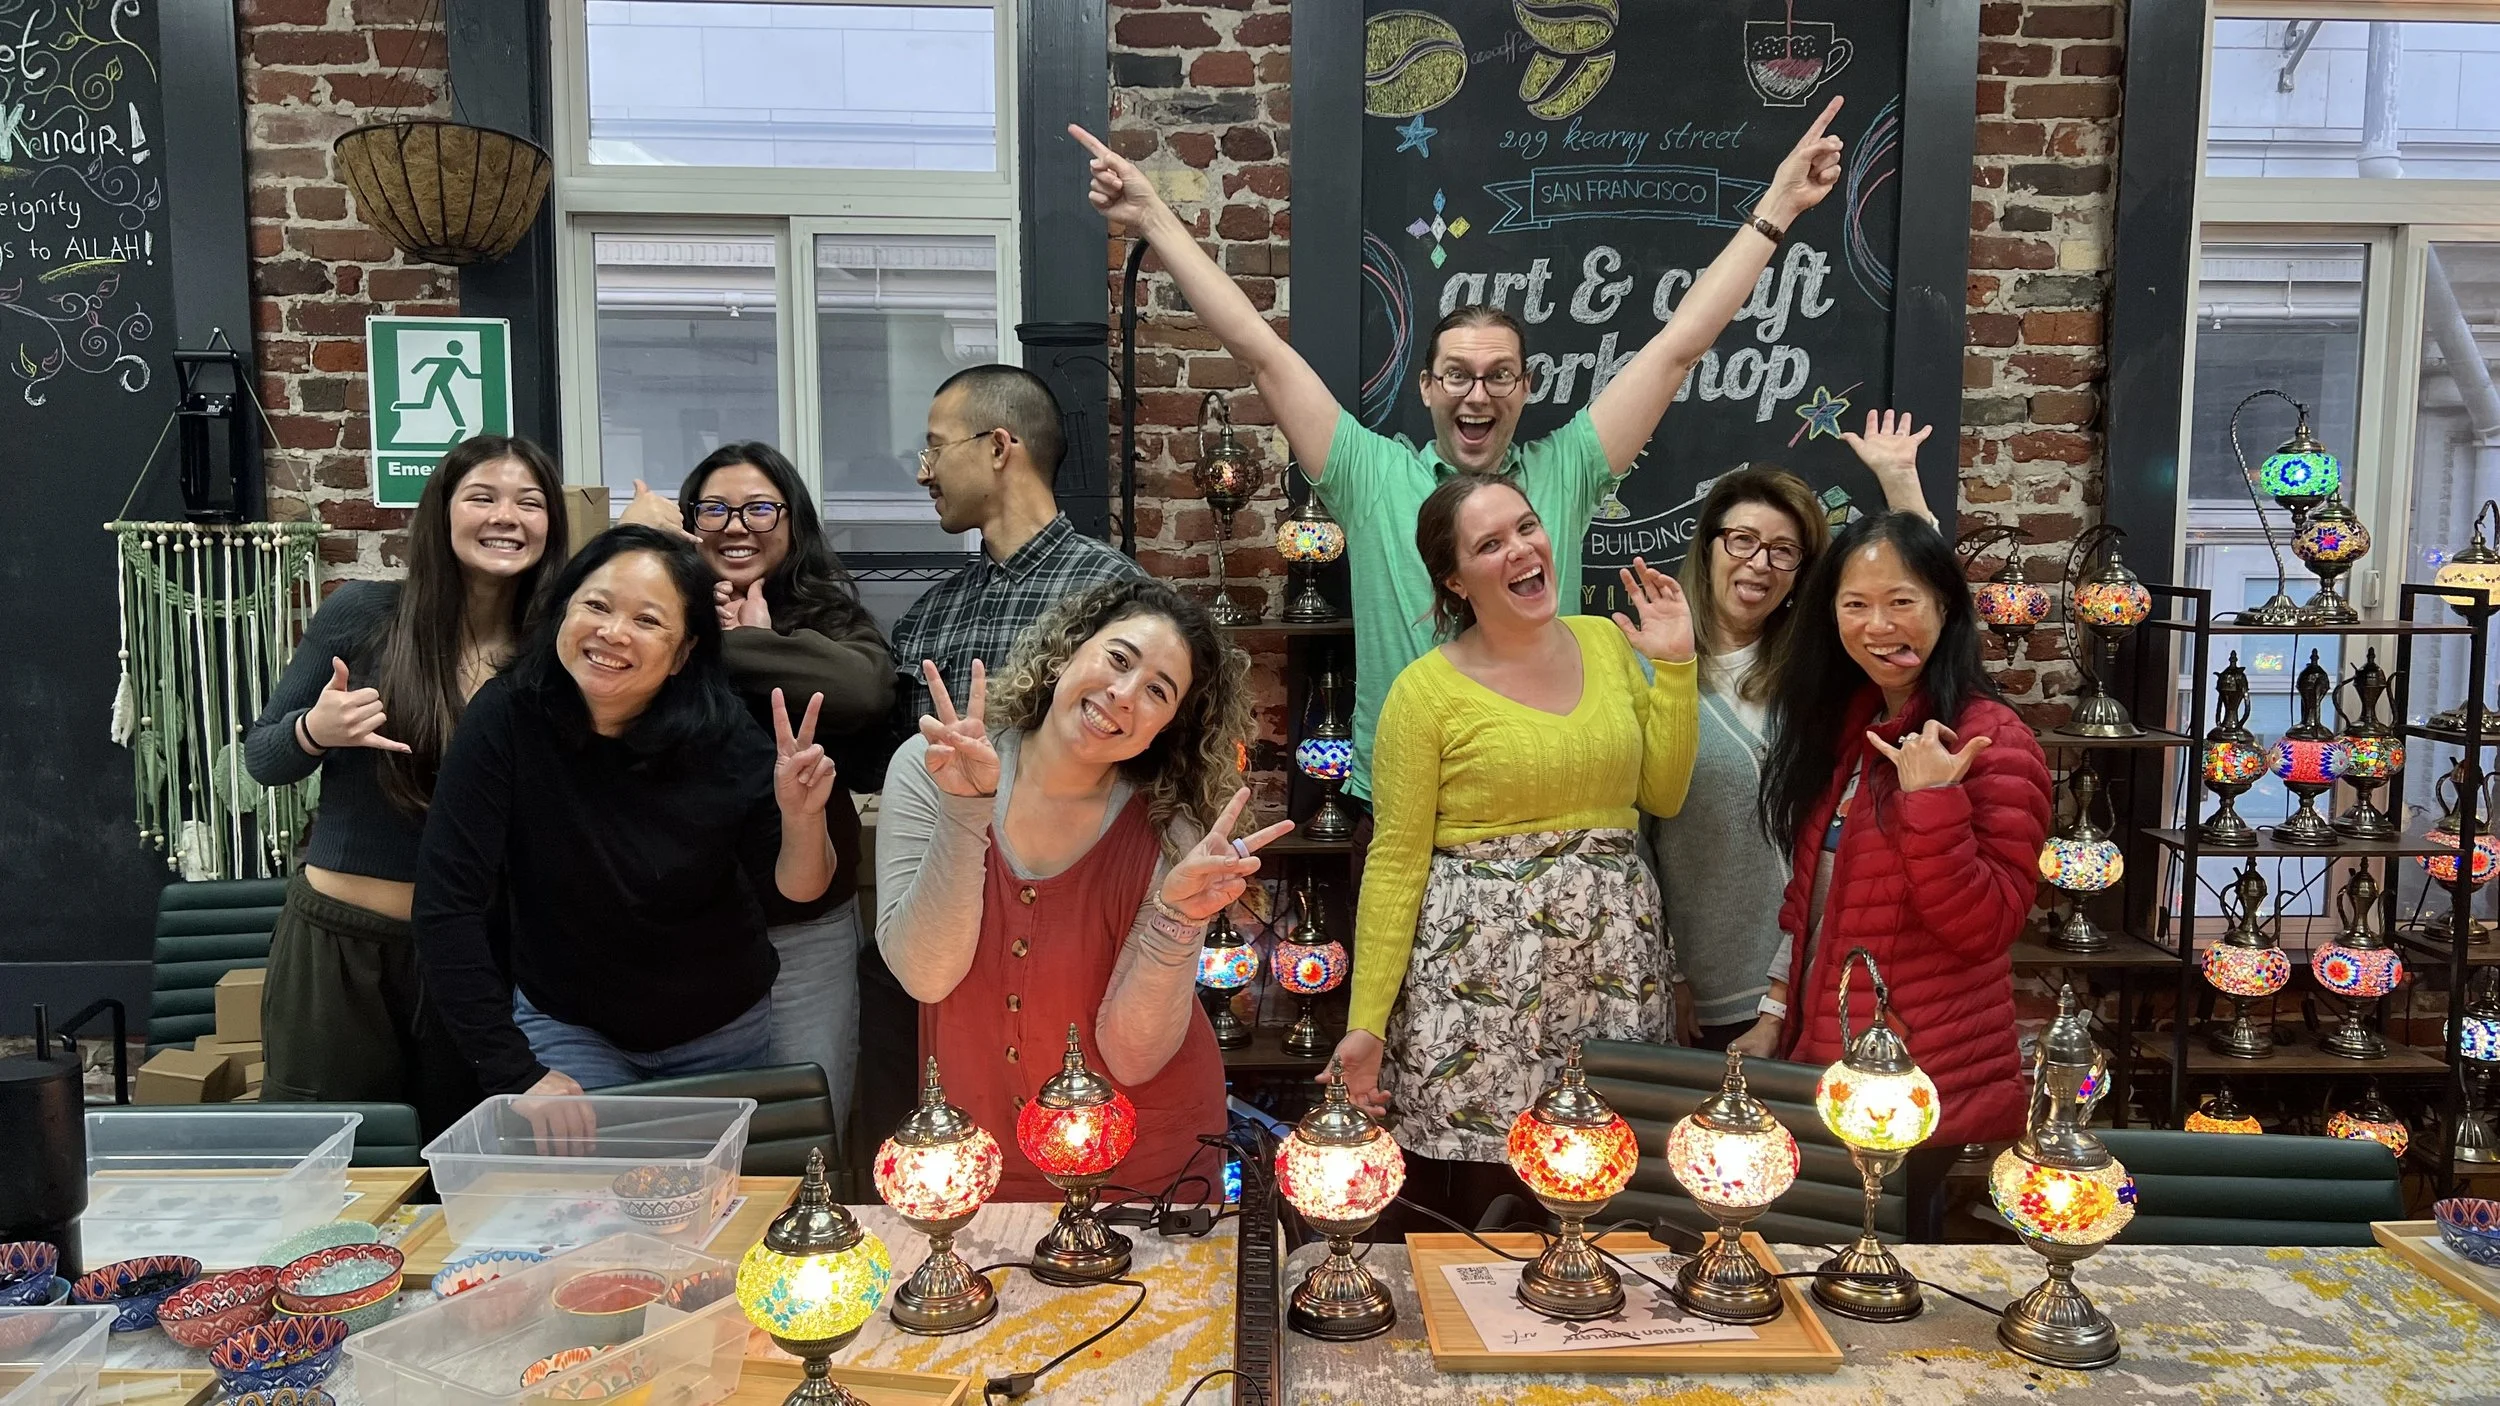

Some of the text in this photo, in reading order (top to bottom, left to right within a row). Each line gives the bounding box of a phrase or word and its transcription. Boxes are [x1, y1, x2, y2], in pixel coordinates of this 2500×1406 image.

[1500, 115, 1748, 166] 209 kearny street
[1541, 179, 1707, 204] SAN FRANCISCO
[29, 239, 50, 260] to
[65, 230, 153, 266] ALLAH!
[1439, 258, 1556, 324] art
[1570, 245, 1634, 324] &
[1591, 517, 1699, 556] BUILDING
